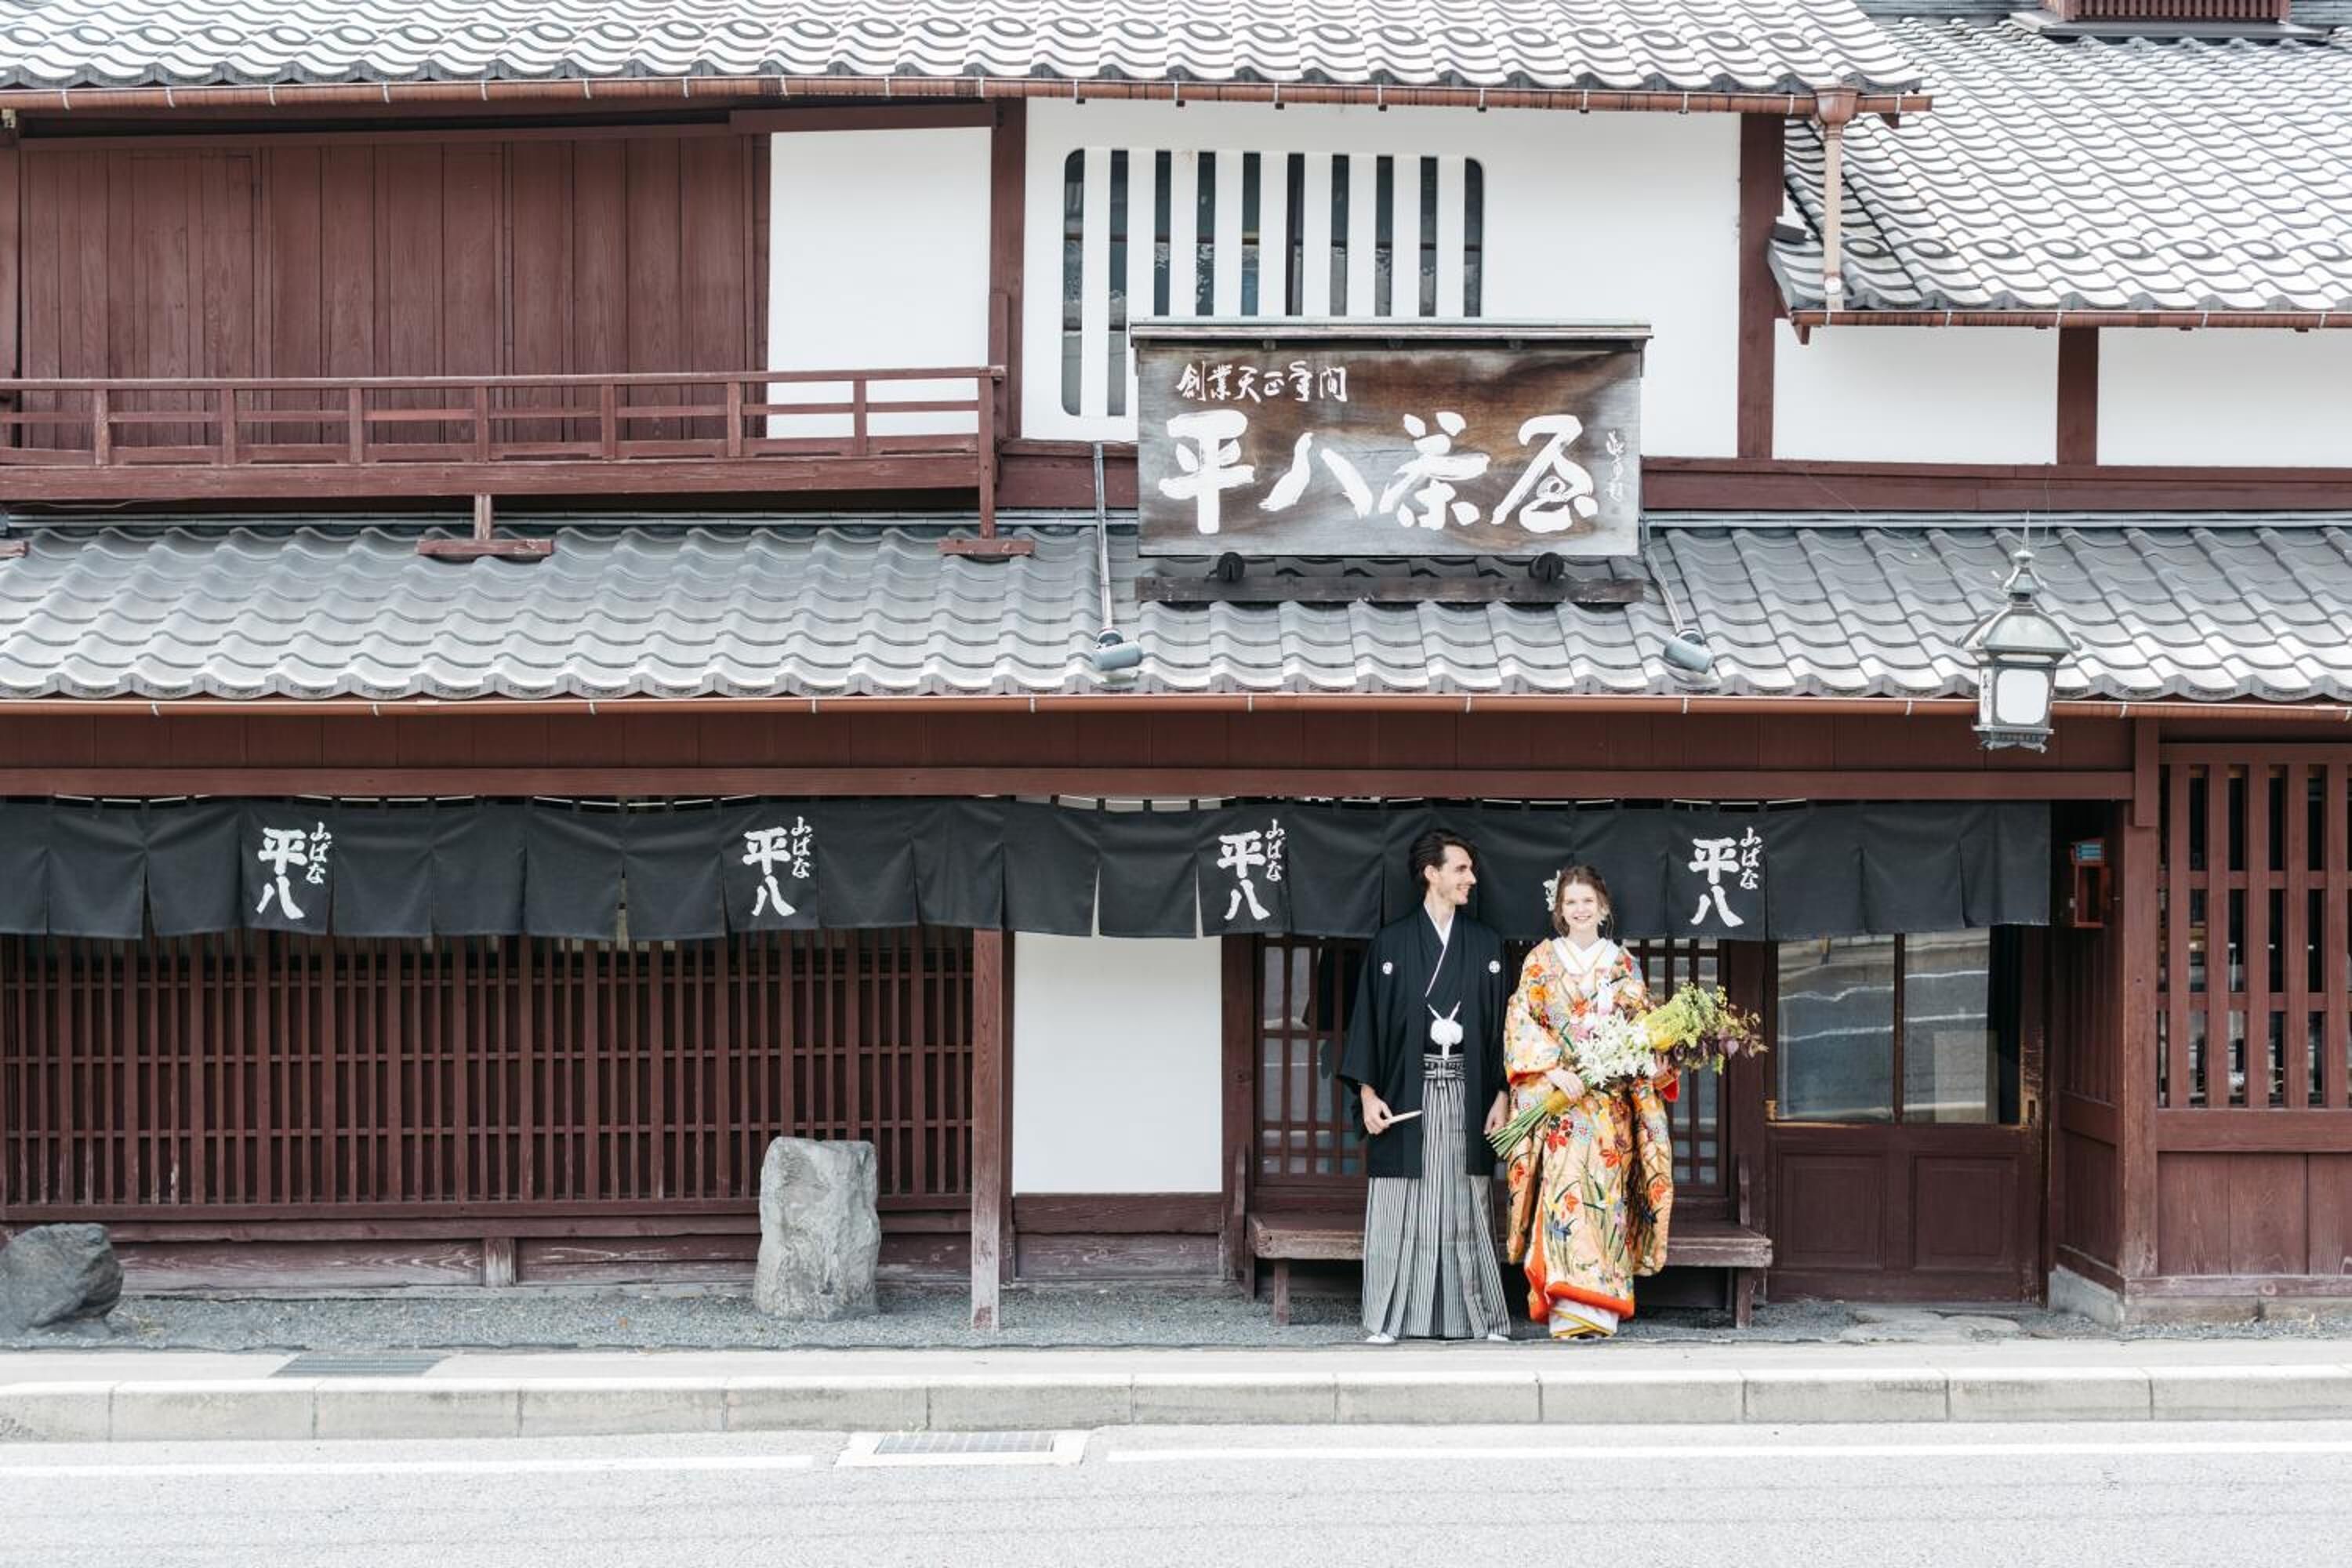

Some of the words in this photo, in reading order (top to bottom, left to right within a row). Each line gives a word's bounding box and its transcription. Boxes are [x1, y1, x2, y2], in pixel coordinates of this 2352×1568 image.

[1175, 360, 1348, 403] 創業天正年間
[1158, 408, 1599, 535] 平八茶屋
[256, 827, 308, 920] 平八
[305, 820, 332, 884] 山ばな
[742, 826, 797, 916] 平八
[789, 815, 813, 879] 山ばな
[1216, 829, 1272, 920] 平八
[1264, 818, 1286, 882] 山ばな
[1688, 837, 1744, 927] 平八
[1738, 826, 1763, 890] 山ばな
